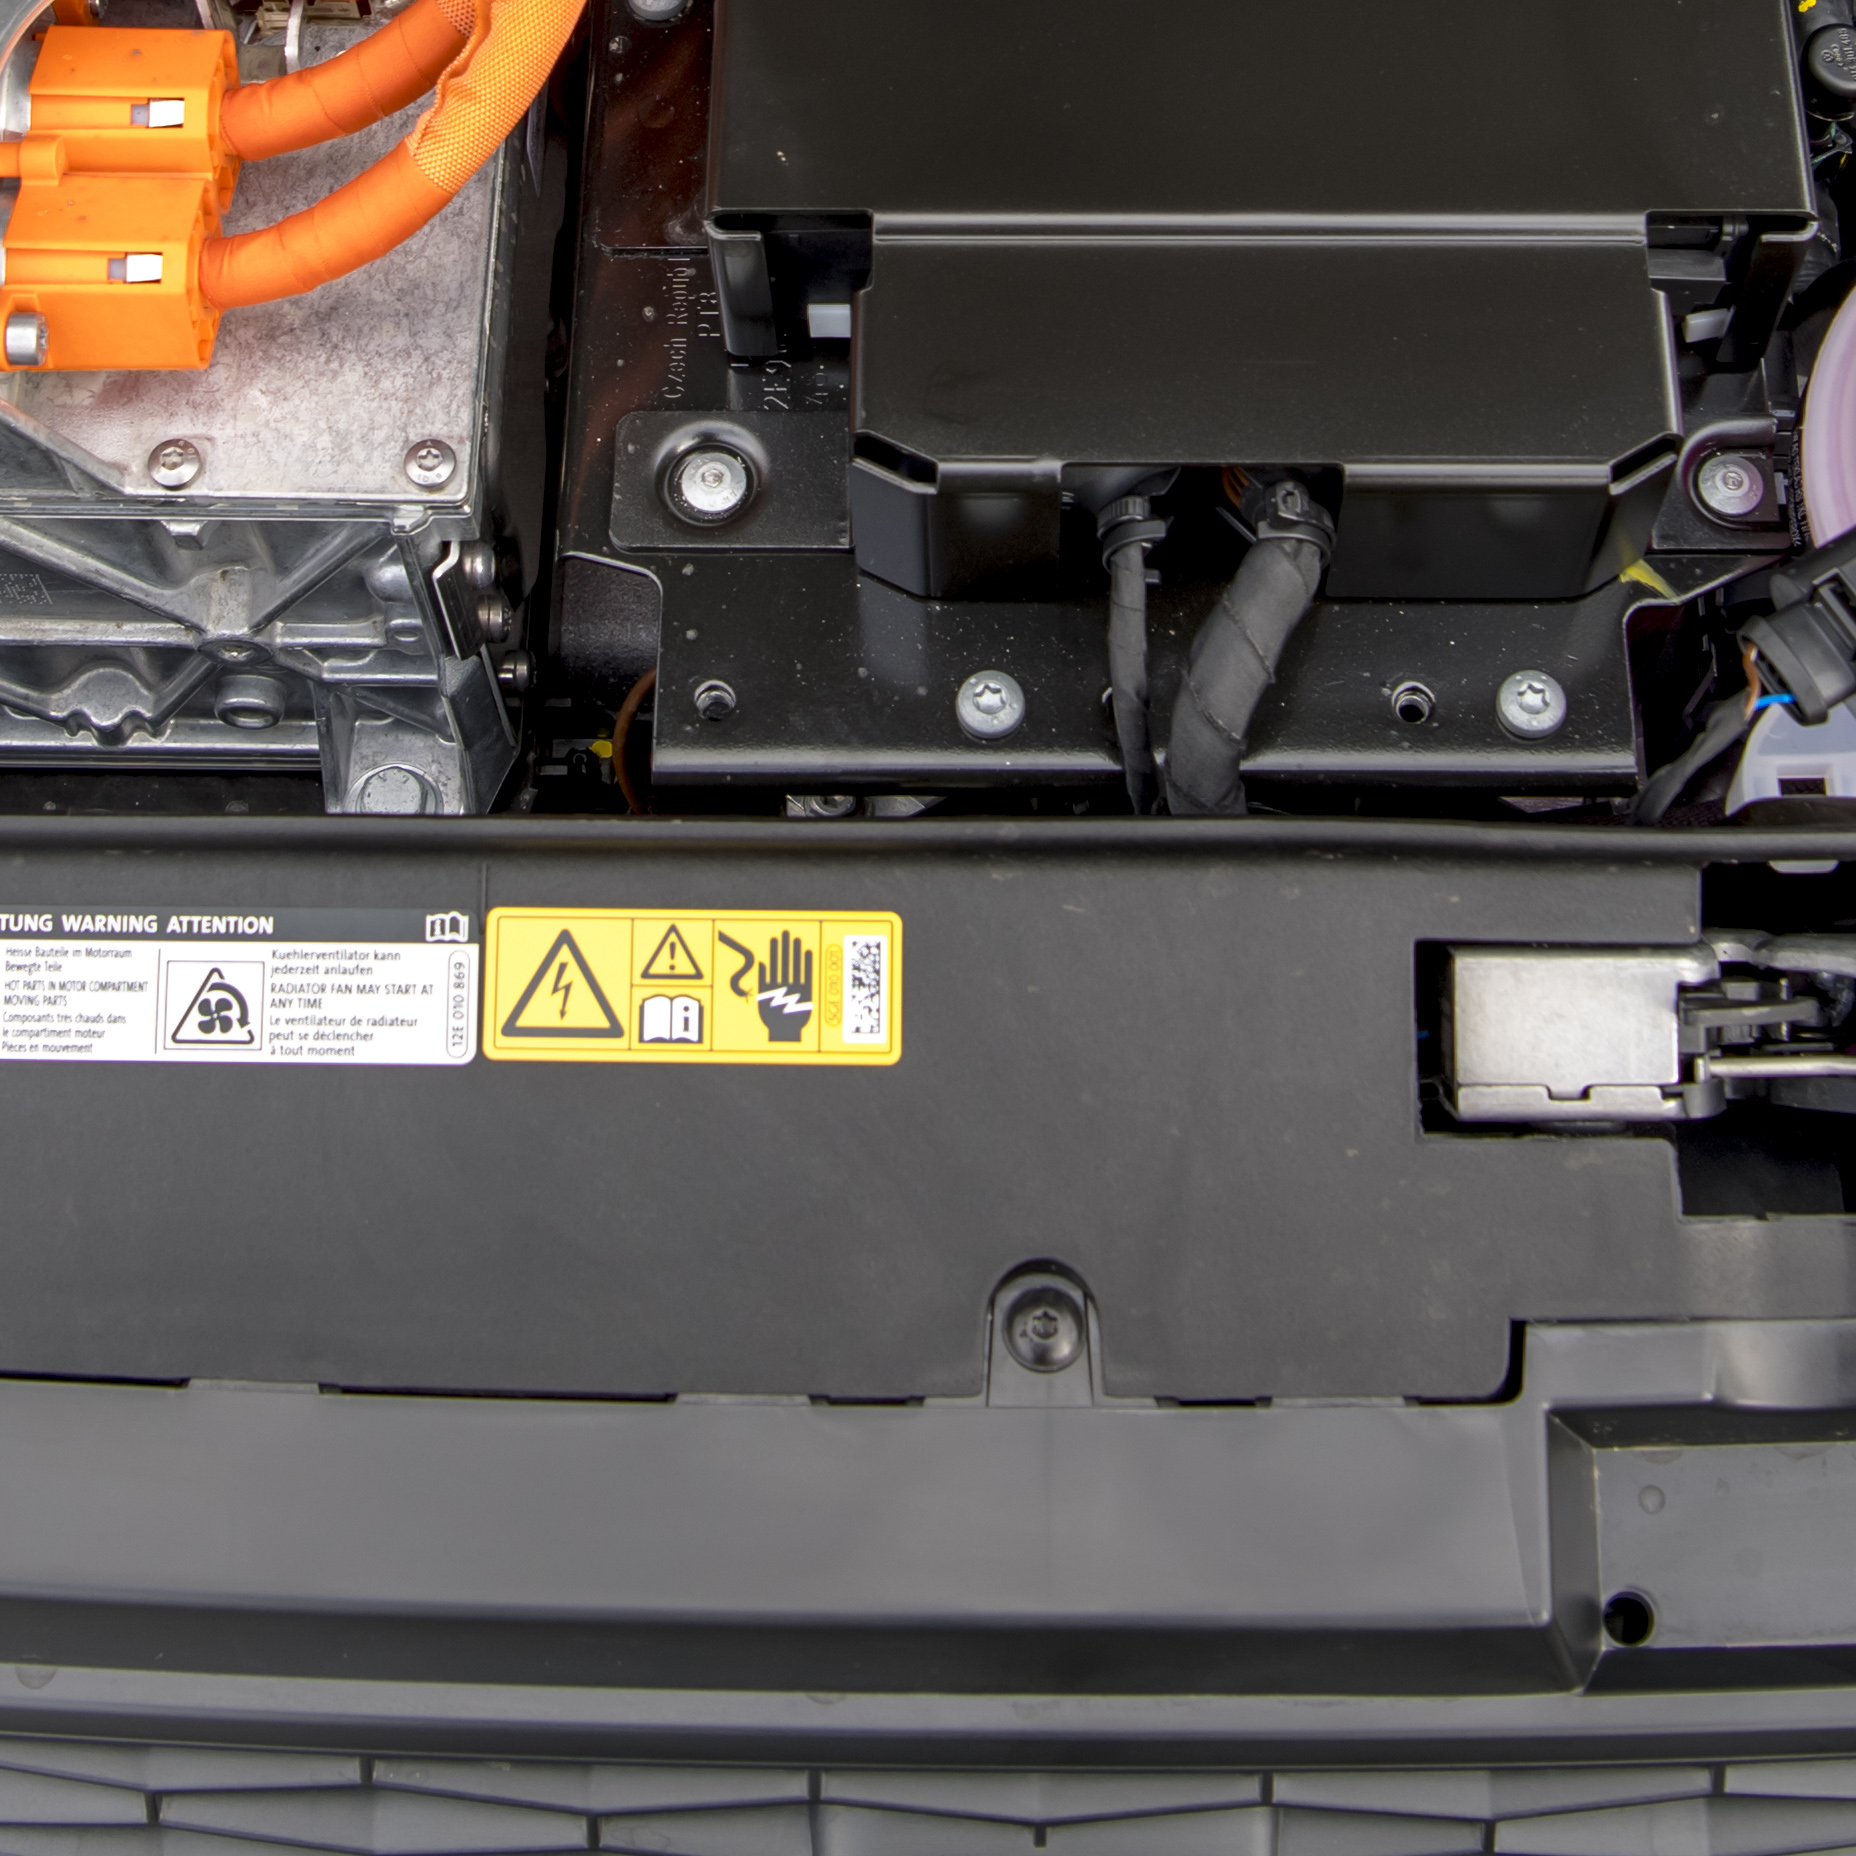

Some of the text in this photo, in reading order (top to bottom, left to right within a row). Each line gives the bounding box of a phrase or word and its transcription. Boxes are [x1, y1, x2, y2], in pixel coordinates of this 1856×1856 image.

[61, 914, 158, 934] WARNING
[166, 915, 274, 935] ATTENTION
[35, 946, 69, 958] Bauteile
[85, 947, 132, 959] Motorraum
[271, 949, 401, 961] Kuehlerventilator kann
[5, 961, 41, 976] Bewegte
[270, 964, 373, 978] jederzeit anlaufen
[4, 980, 148, 992] HOT PARTS IN MOTOR COMPARTMENT
[270, 983, 434, 995] RADIATOR FAN MAY START AT
[4, 995, 67, 1007] MOVING PARTS
[270, 998, 322, 1009] ANY TIME
[452, 961, 466, 1046] 12E 010 869
[3, 1011, 54, 1025] Composants
[75, 1012, 104, 1024] chauds
[107, 1013, 126, 1025] dans
[285, 1015, 346, 1027] ventilateur
[350, 1015, 362, 1027] de
[366, 1015, 418, 1027] radiateur
[11, 1027, 71, 1040] compartiment
[75, 1028, 105, 1039] moteur
[269, 1031, 294, 1044] peut
[298, 1032, 309, 1041] se
[42, 1043, 93, 1054] mouvement
[280, 1045, 303, 1056] tout
[307, 1045, 355, 1057] moment
